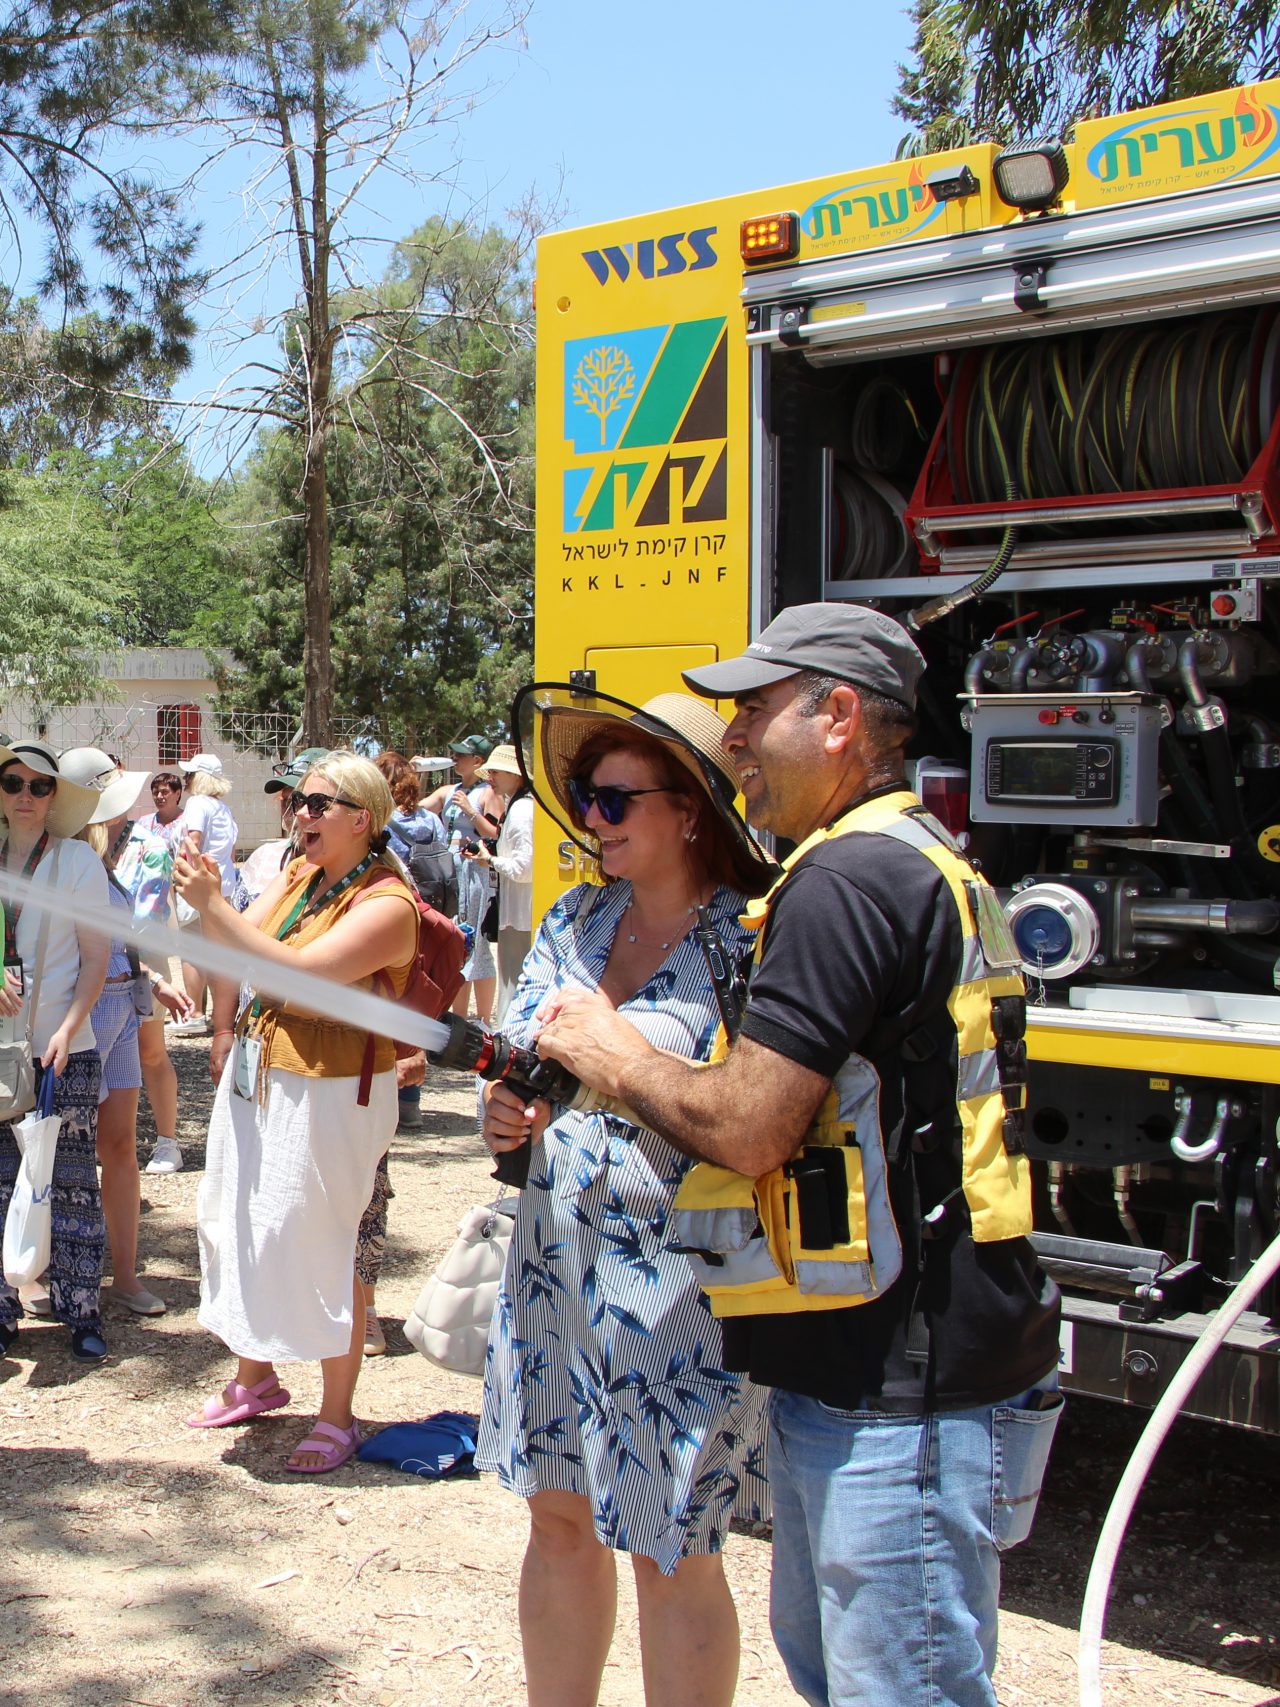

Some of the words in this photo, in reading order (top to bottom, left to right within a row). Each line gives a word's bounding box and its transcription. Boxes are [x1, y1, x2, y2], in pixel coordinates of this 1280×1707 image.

[1101, 113, 1256, 183] יערית
[1137, 178, 1161, 189] קימת
[1165, 175, 1180, 185] קרן
[1195, 170, 1210, 178] אש
[1100, 182, 1134, 194] לישראל
[811, 185, 924, 240] יערית
[581, 226, 717, 287] WISS
[562, 538, 629, 561] לישראל
[636, 538, 686, 557] קימת
[695, 534, 727, 556] קרן
